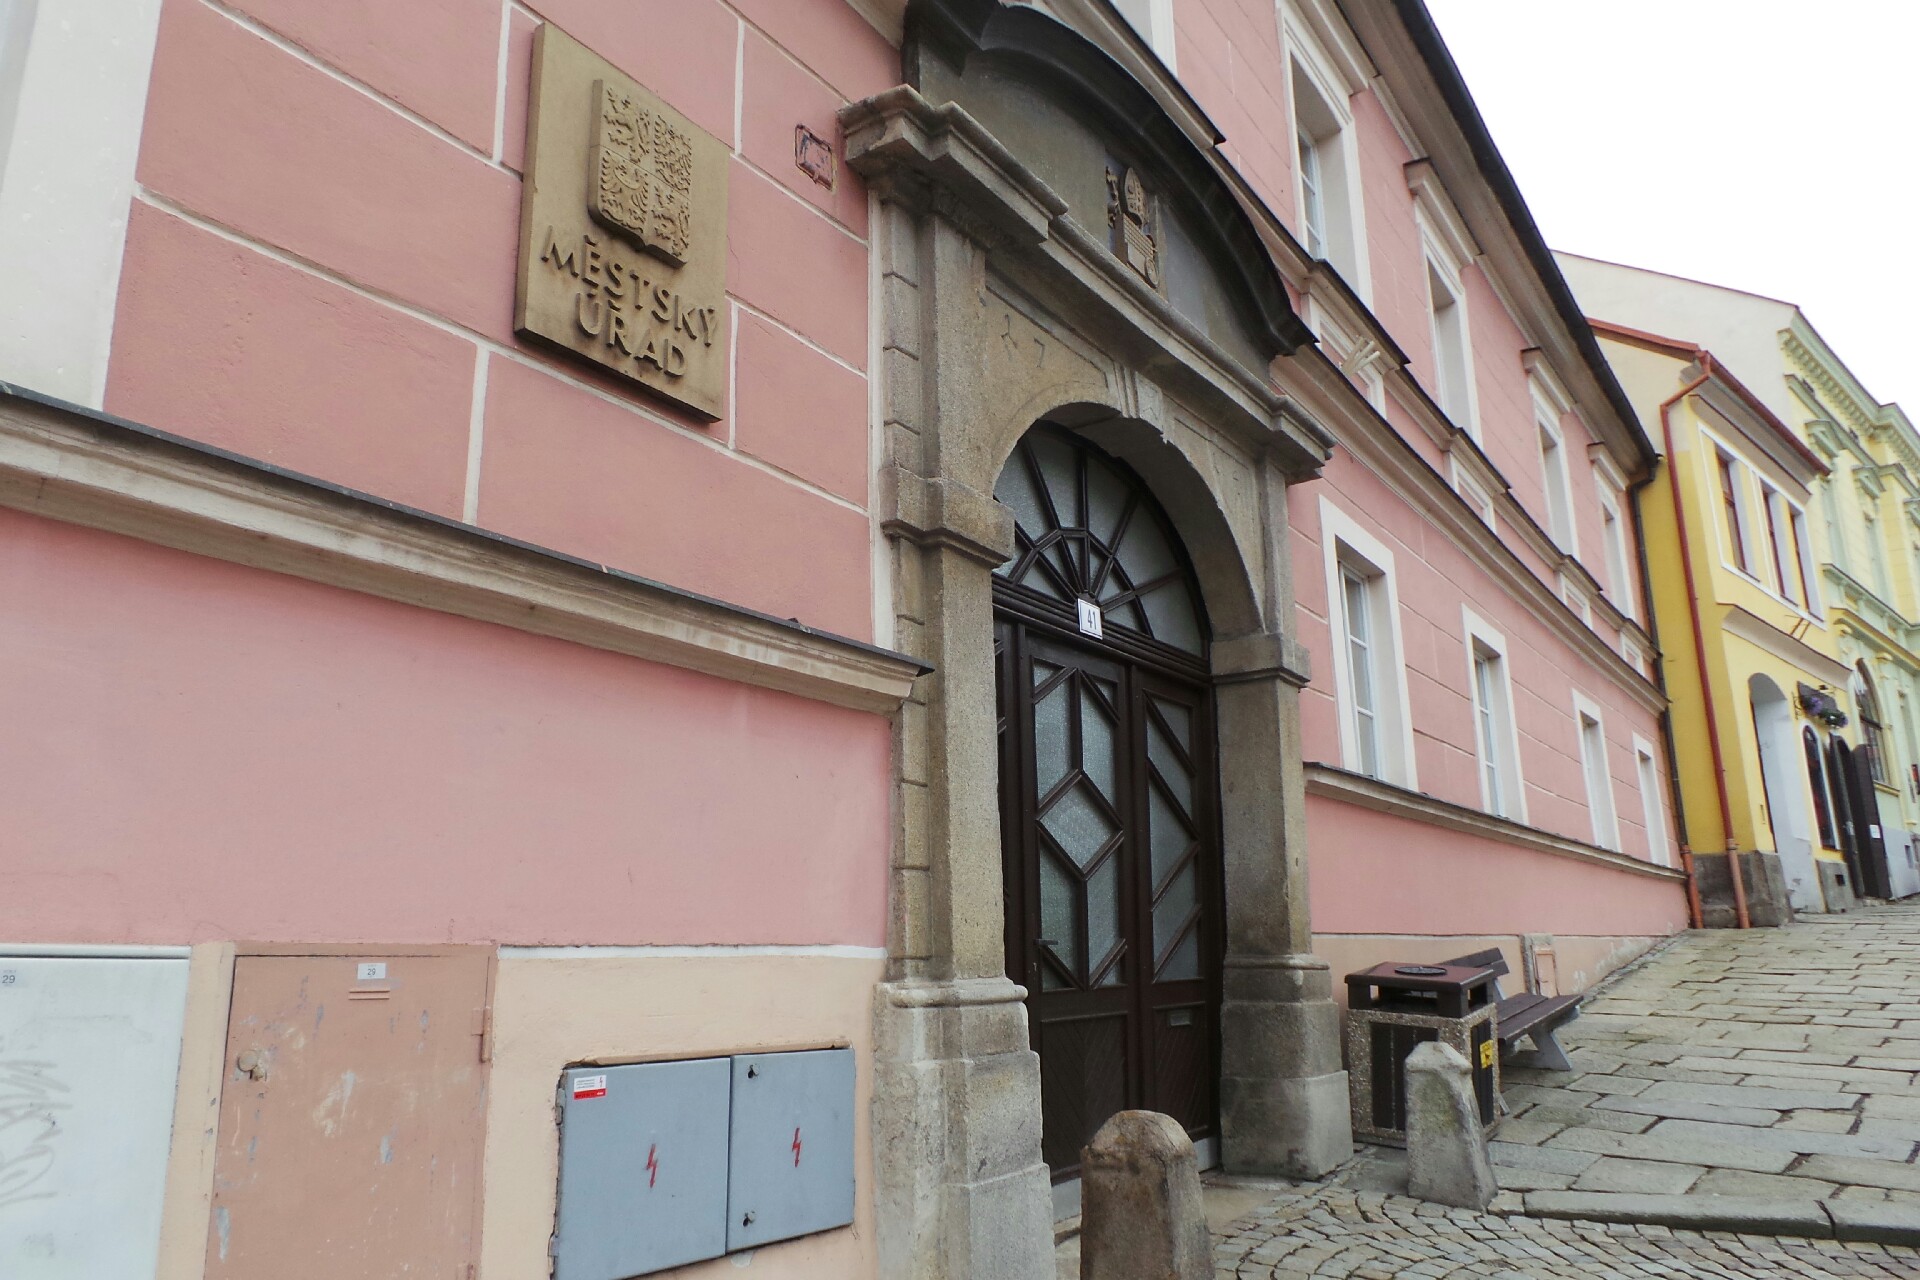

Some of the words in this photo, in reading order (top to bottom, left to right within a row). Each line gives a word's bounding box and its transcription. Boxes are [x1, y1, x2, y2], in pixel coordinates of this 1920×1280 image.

[541, 225, 718, 347] MĚSTSKÝ
[575, 290, 687, 377] ÚŘAD
[1087, 609, 1097, 630] 41
[2, 975, 15, 983] 29
[367, 968, 376, 976] 29
